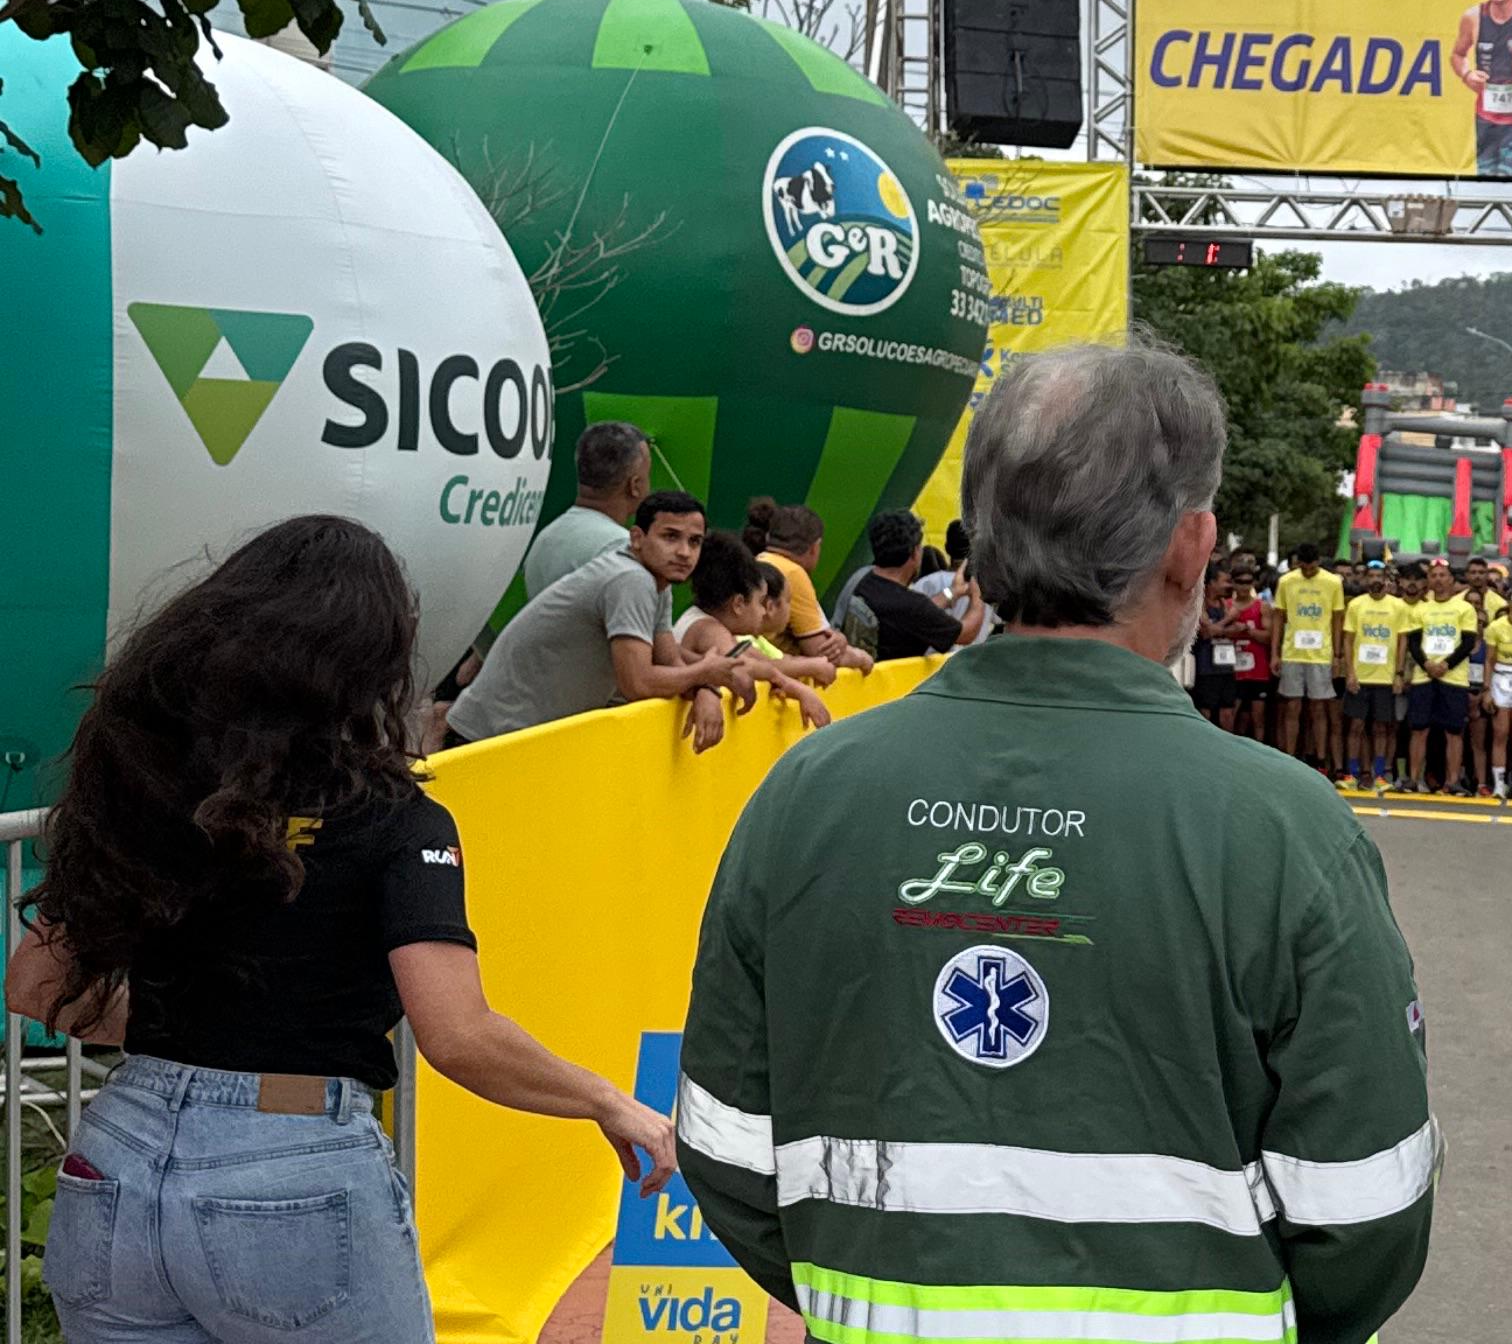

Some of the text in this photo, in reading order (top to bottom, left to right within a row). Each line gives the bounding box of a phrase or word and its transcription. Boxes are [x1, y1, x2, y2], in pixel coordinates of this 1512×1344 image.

[1150, 29, 1443, 97] CHEGADA
[321, 342, 552, 460] SICOO
[907, 798, 1086, 838] CONDUTOR
[898, 841, 1066, 907] Life
[638, 1286, 741, 1333] vida
